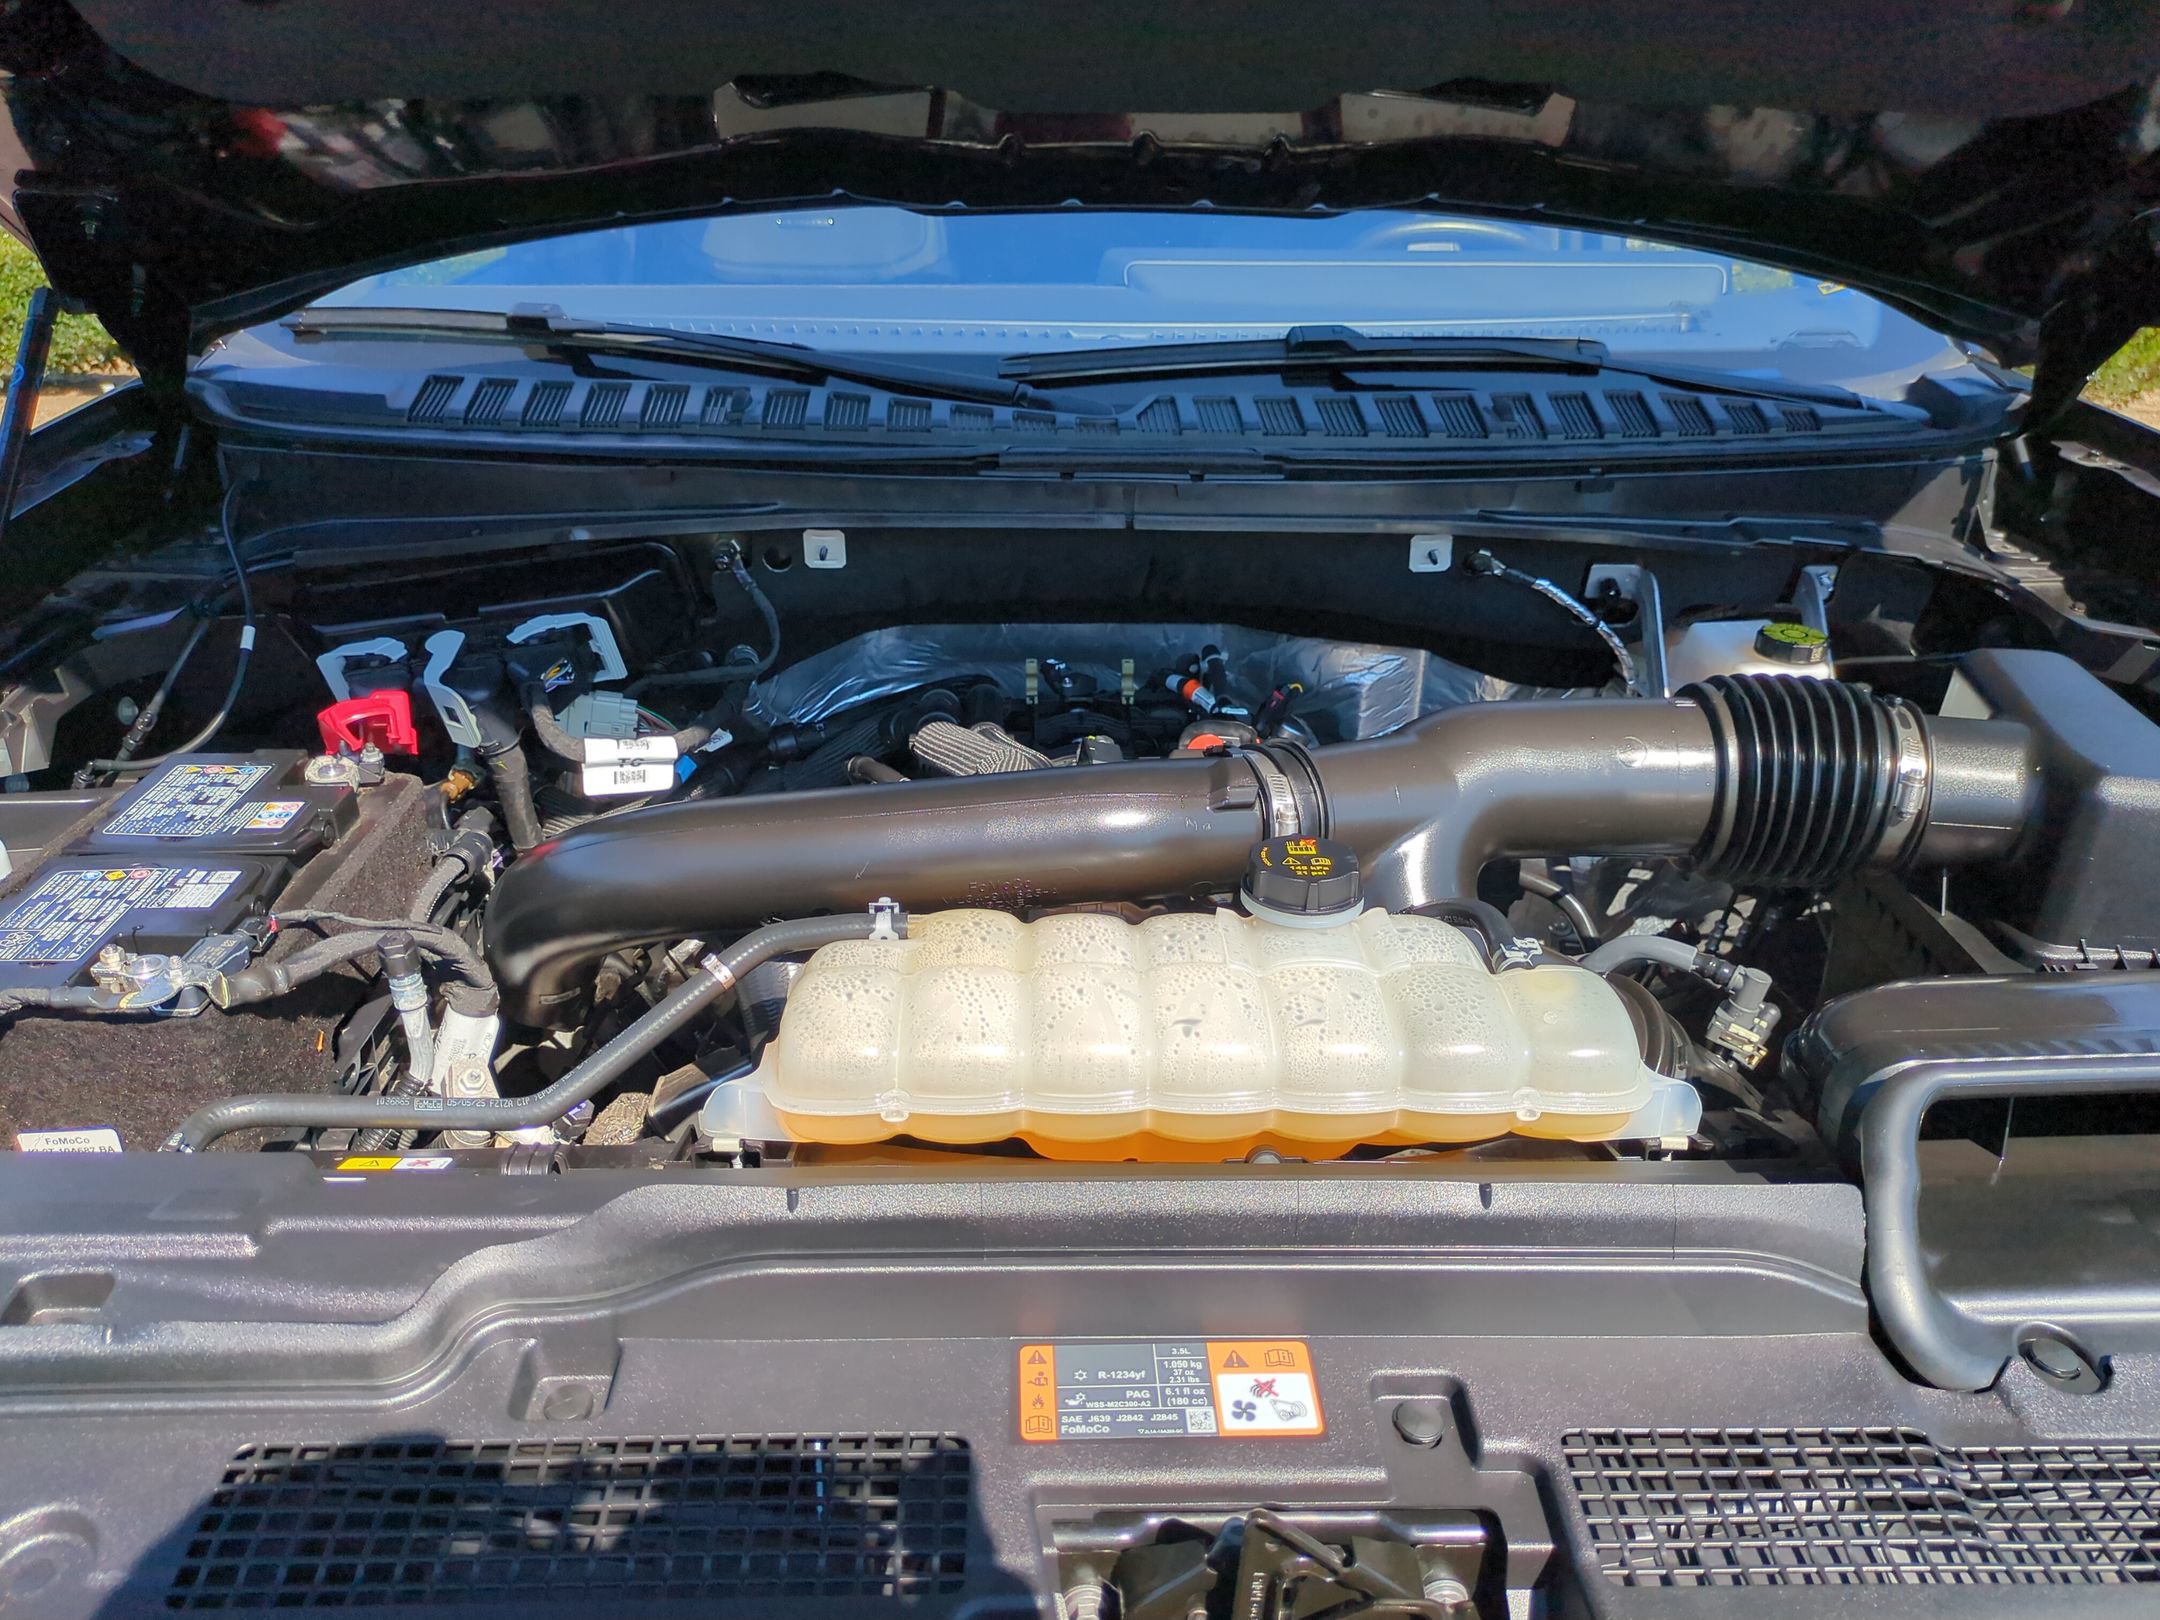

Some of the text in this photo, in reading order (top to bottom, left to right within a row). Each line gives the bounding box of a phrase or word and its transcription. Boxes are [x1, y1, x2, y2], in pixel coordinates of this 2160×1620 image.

[415, 1099, 442, 1109] FoMoCo
[44, 1136, 90, 1145] FoMoCo
[1171, 1347, 1191, 1355] 3.5L
[1163, 1360, 1202, 1370] 1.050 kg
[1097, 1370, 1146, 1380] R-1234yf
[1125, 1390, 1151, 1399] PAG
[1165, 1387, 1180, 1395] 6.1
[1183, 1387, 1190, 1395] fl
[1085, 1400, 1151, 1408] WSS-M2C300-A2
[1167, 1396, 1208, 1406] (180 cc)
[1061, 1413, 1178, 1423] SAE J639 J2842 J2845
[1061, 1424, 1110, 1434] FoMoCo
